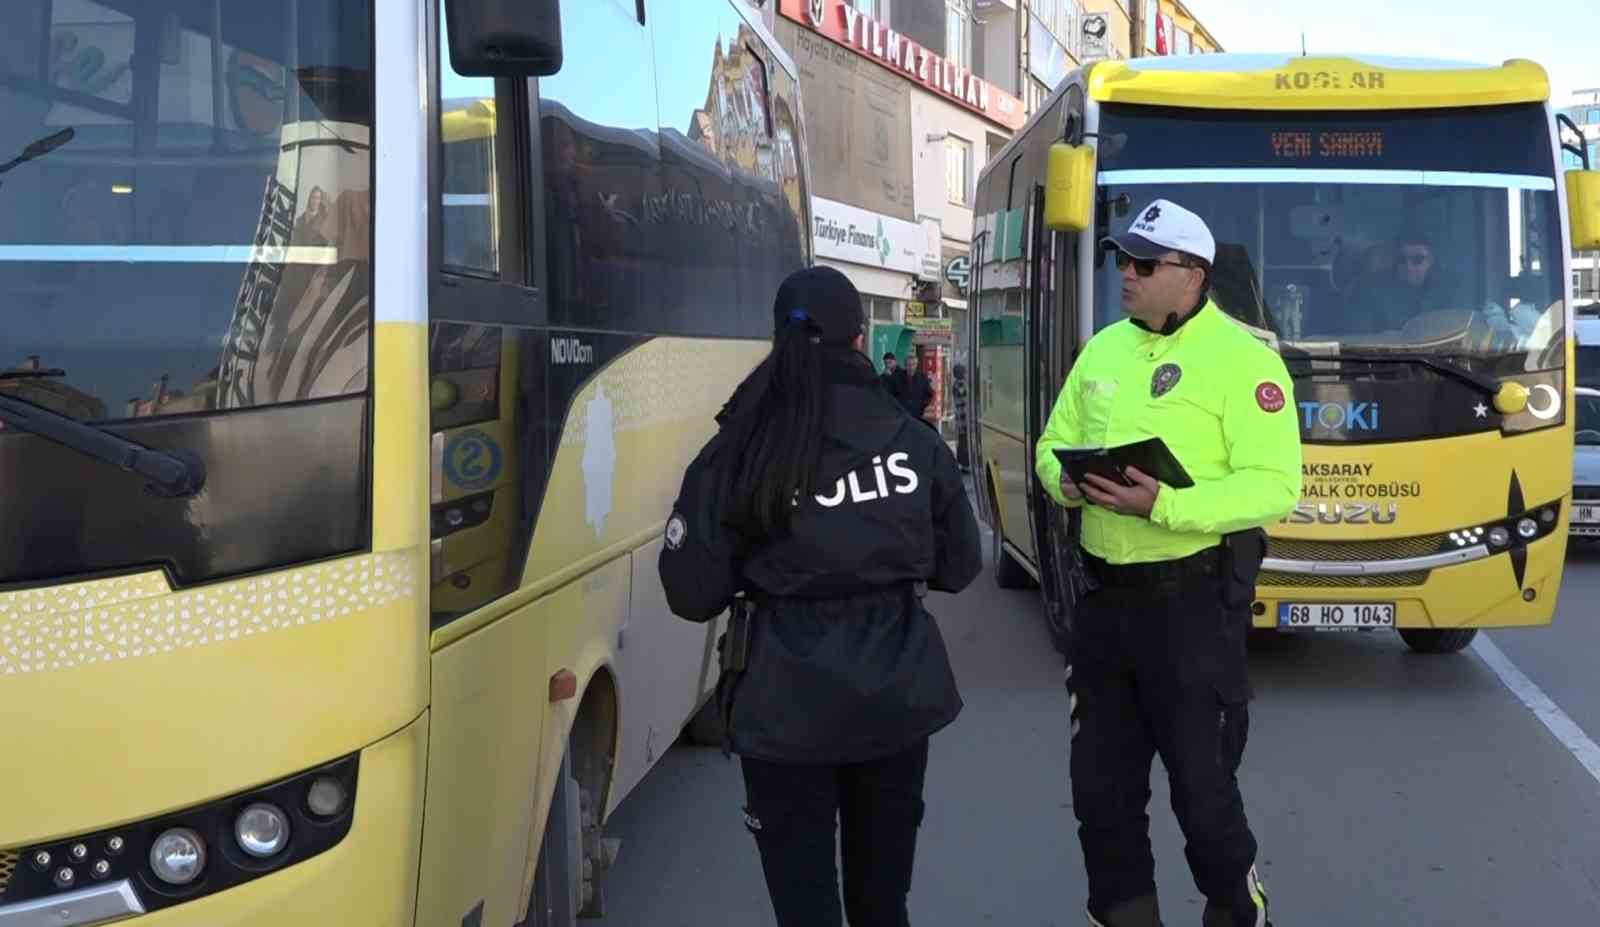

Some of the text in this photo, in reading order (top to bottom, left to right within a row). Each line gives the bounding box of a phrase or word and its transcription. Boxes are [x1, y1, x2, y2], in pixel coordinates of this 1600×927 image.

[844, 4, 928, 80] YILMAZ
[814, 215, 875, 249] Türkiye Finans
[791, 451, 919, 507] OLİS
[1301, 463, 1373, 476] AKSARAY
[1300, 481, 1421, 498] HALK OTOBÜSÜ
[1290, 606, 1392, 624] 68 HO 1043
